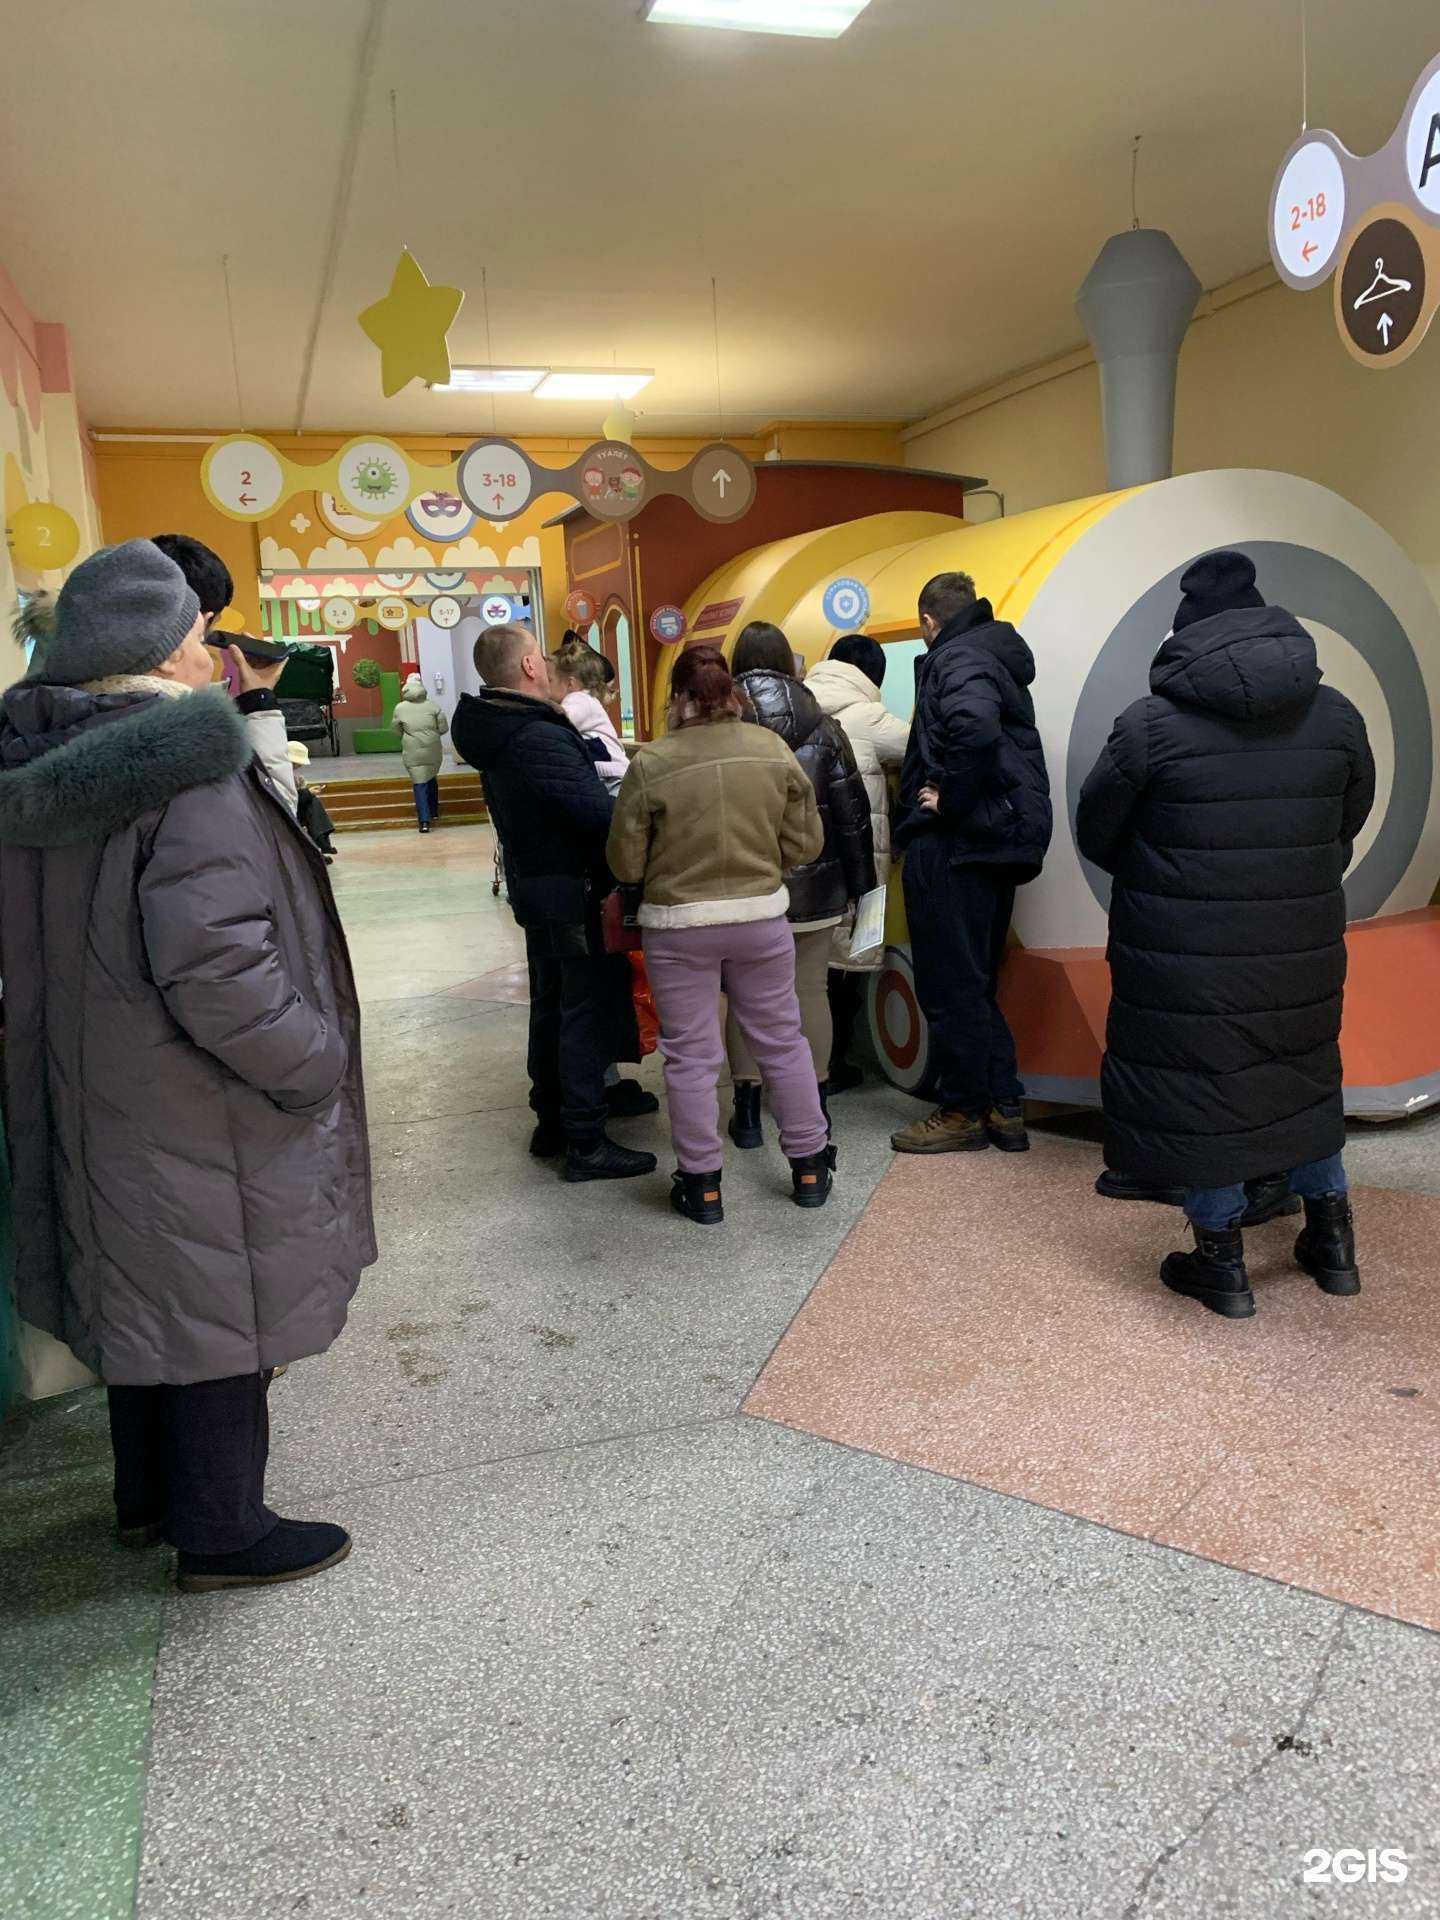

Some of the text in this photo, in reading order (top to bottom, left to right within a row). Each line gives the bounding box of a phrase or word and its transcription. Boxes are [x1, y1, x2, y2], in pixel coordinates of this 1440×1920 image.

[1291, 192, 1326, 231] 2-18
[597, 449, 629, 460] ТУАЛЕТ
[240, 471, 252, 485] 2
[482, 473, 517, 488] 3-18
[38, 526, 51, 547] 2
